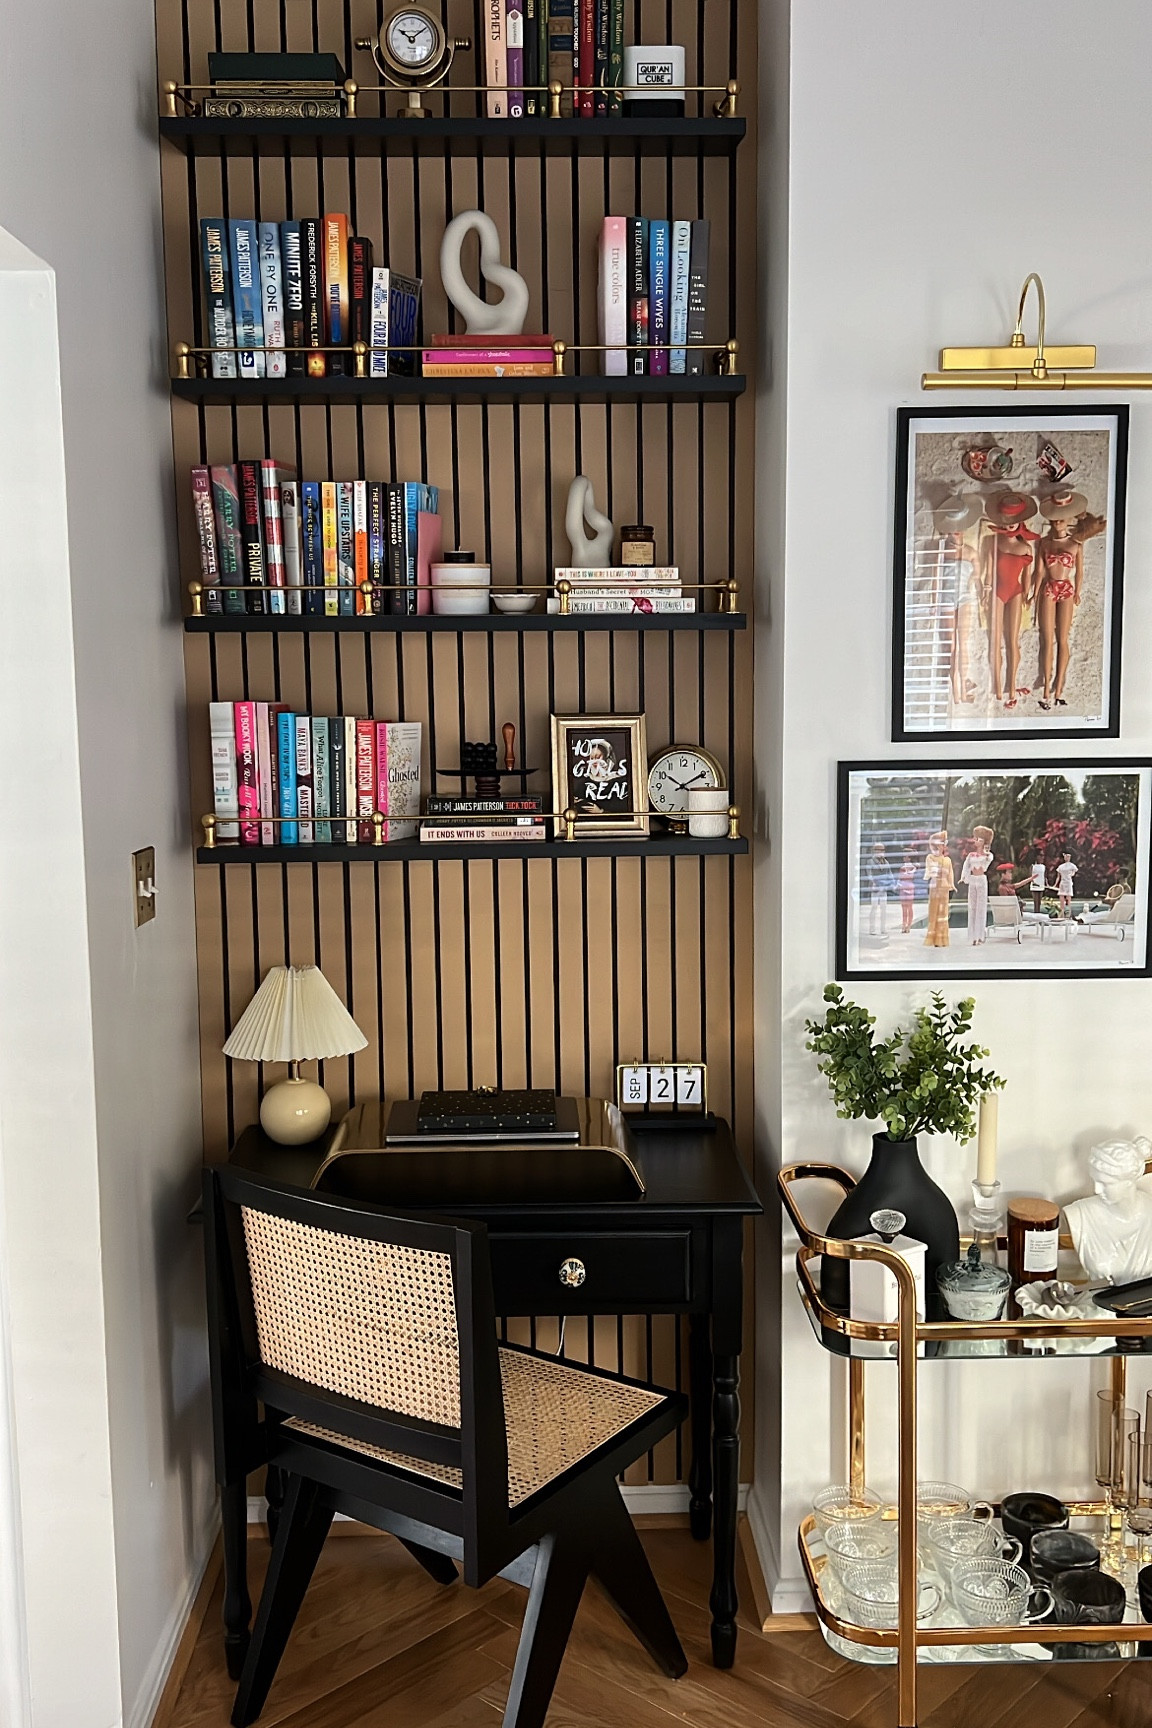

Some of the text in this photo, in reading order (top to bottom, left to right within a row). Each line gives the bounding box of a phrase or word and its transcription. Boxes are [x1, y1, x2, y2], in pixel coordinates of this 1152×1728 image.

[615, 13, 623, 45] Wisdom
[640, 65, 670, 73] QUR'AN
[645, 75, 665, 83] CUBE
[235, 227, 250, 251] JAMES
[284, 232, 301, 277] MINUTE
[328, 221, 341, 279] JAMES PATTERSON
[353, 242, 364, 262] JAMES
[206, 226, 225, 293] JAMES PATTERSON
[237, 251, 253, 288] PATTERSON
[264, 232, 278, 313] ONE BY ONE
[307, 222, 317, 299] FREDERICK FORSYTH
[612, 248, 622, 304] true colors
[634, 229, 643, 292] ELIZABETH ADLER
[673, 227, 688, 303] On Looking
[287, 280, 303, 310] ZERO
[353, 264, 365, 299] PATTERSON
[374, 282, 382, 309] PATTERSON
[655, 227, 664, 329] THREE SINGLE WIVES
[213, 307, 226, 336] MURDER
[310, 312, 318, 332] KILL
[680, 306, 688, 342] Alexandra
[215, 336, 229, 359] HOSE
[268, 333, 276, 355] WAE
[372, 320, 387, 373] FOUR MICE
[242, 464, 258, 525] JAMES PATTERSON
[340, 496, 350, 518] WIFE
[406, 488, 416, 532] UGLY LOVE
[201, 491, 216, 574] HARRY POTTER
[223, 491, 237, 573] HARRY POTTER
[341, 520, 351, 560] UPSTAIRS
[248, 542, 262, 582] PRIVATE
[308, 553, 313, 561] US
[570, 570, 581, 578] THIS
[581, 570, 587, 578] IS
[588, 570, 605, 578] WHERE
[627, 570, 637, 578] YOU
[240, 705, 252, 765] MY BOOKY WOOK
[297, 728, 307, 772] MAYA BANKS
[316, 735, 325, 798] What Alice Forgot
[358, 733, 372, 790] JAMES PATTERSON
[388, 766, 419, 782] Ghosted
[573, 759, 627, 778] GIRLS
[659, 771, 667, 779] 10
[679, 759, 688, 767] 12
[655, 783, 662, 791] 9
[660, 795, 666, 803] 8
[299, 789, 310, 828] MASTERD
[453, 801, 504, 811] JAMES PATTERSON
[505, 801, 537, 810] TICK TOCK
[629, 1078, 695, 1100] SEP 2 7
